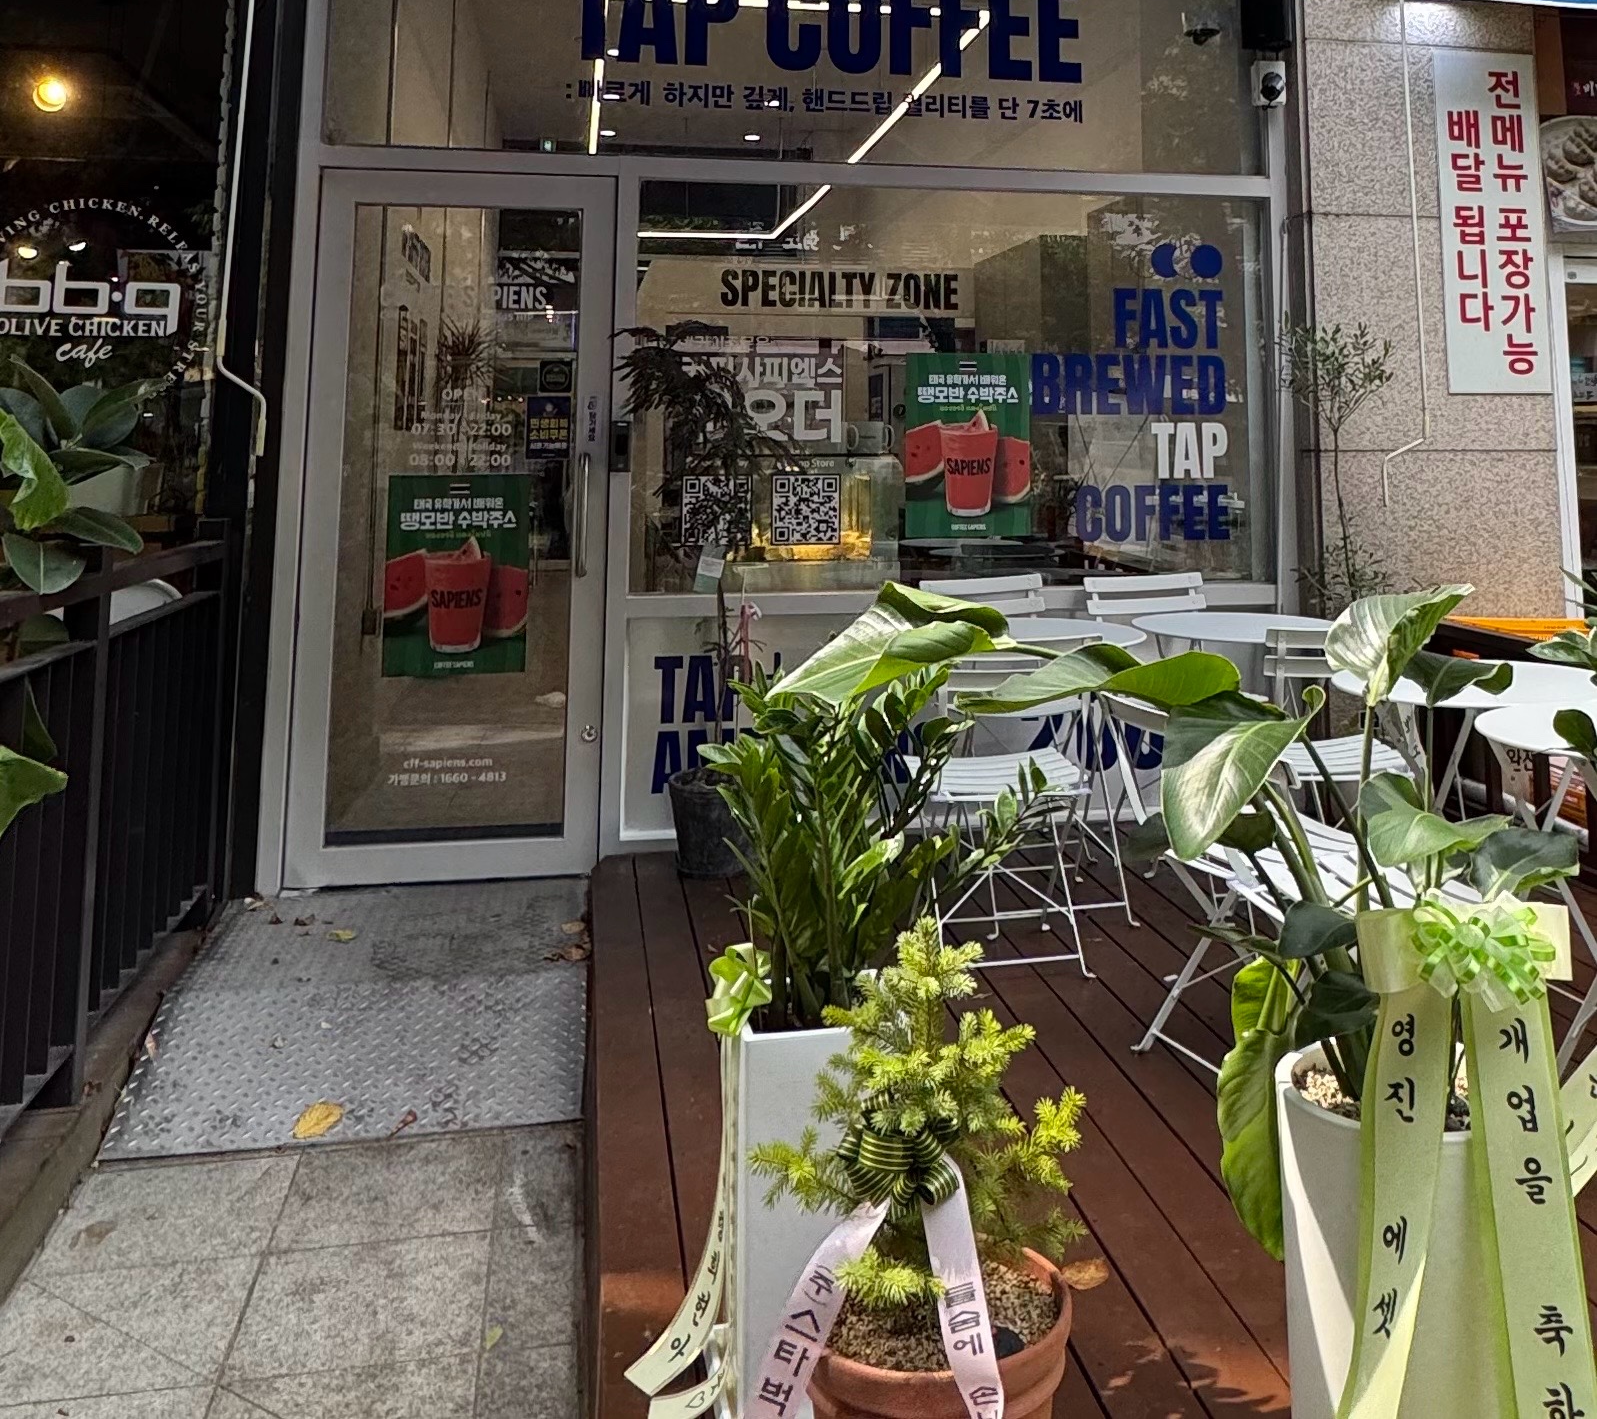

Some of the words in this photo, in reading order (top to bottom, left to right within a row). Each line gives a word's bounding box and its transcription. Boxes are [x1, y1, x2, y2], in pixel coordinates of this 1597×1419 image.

[662, 81, 735, 109] 하지만
[801, 87, 893, 116] 핸드드립
[997, 96, 1020, 121] 단
[1026, 98, 1084, 124] 7초에
[1486, 69, 1529, 194] 전메뉴
[1446, 109, 1484, 194] 배달
[720, 268, 877, 310] SPECIALTY
[885, 272, 960, 311] ZONE
[1452, 205, 1495, 333] 됩니다
[1495, 207, 1539, 377] 포장가능
[68, 316, 166, 338] CHICKEN
[1113, 287, 1225, 350] FAST
[55, 338, 113, 369] cafe
[917, 386, 965, 404] 땡모반
[967, 386, 1020, 404] 수박주스
[1031, 353, 1228, 417] BREWED
[470, 423, 512, 436] 22:00
[1151, 422, 1229, 480] TAP
[946, 457, 992, 477] SAPIENS
[400, 511, 455, 531] 땡모반
[457, 510, 518, 530] 수박주스
[1075, 484, 1231, 543] COFFEE
[430, 589, 484, 610] SAPIENS
[1383, 1013, 1416, 1124] 영진
[1498, 1017, 1554, 1206] 개업을
